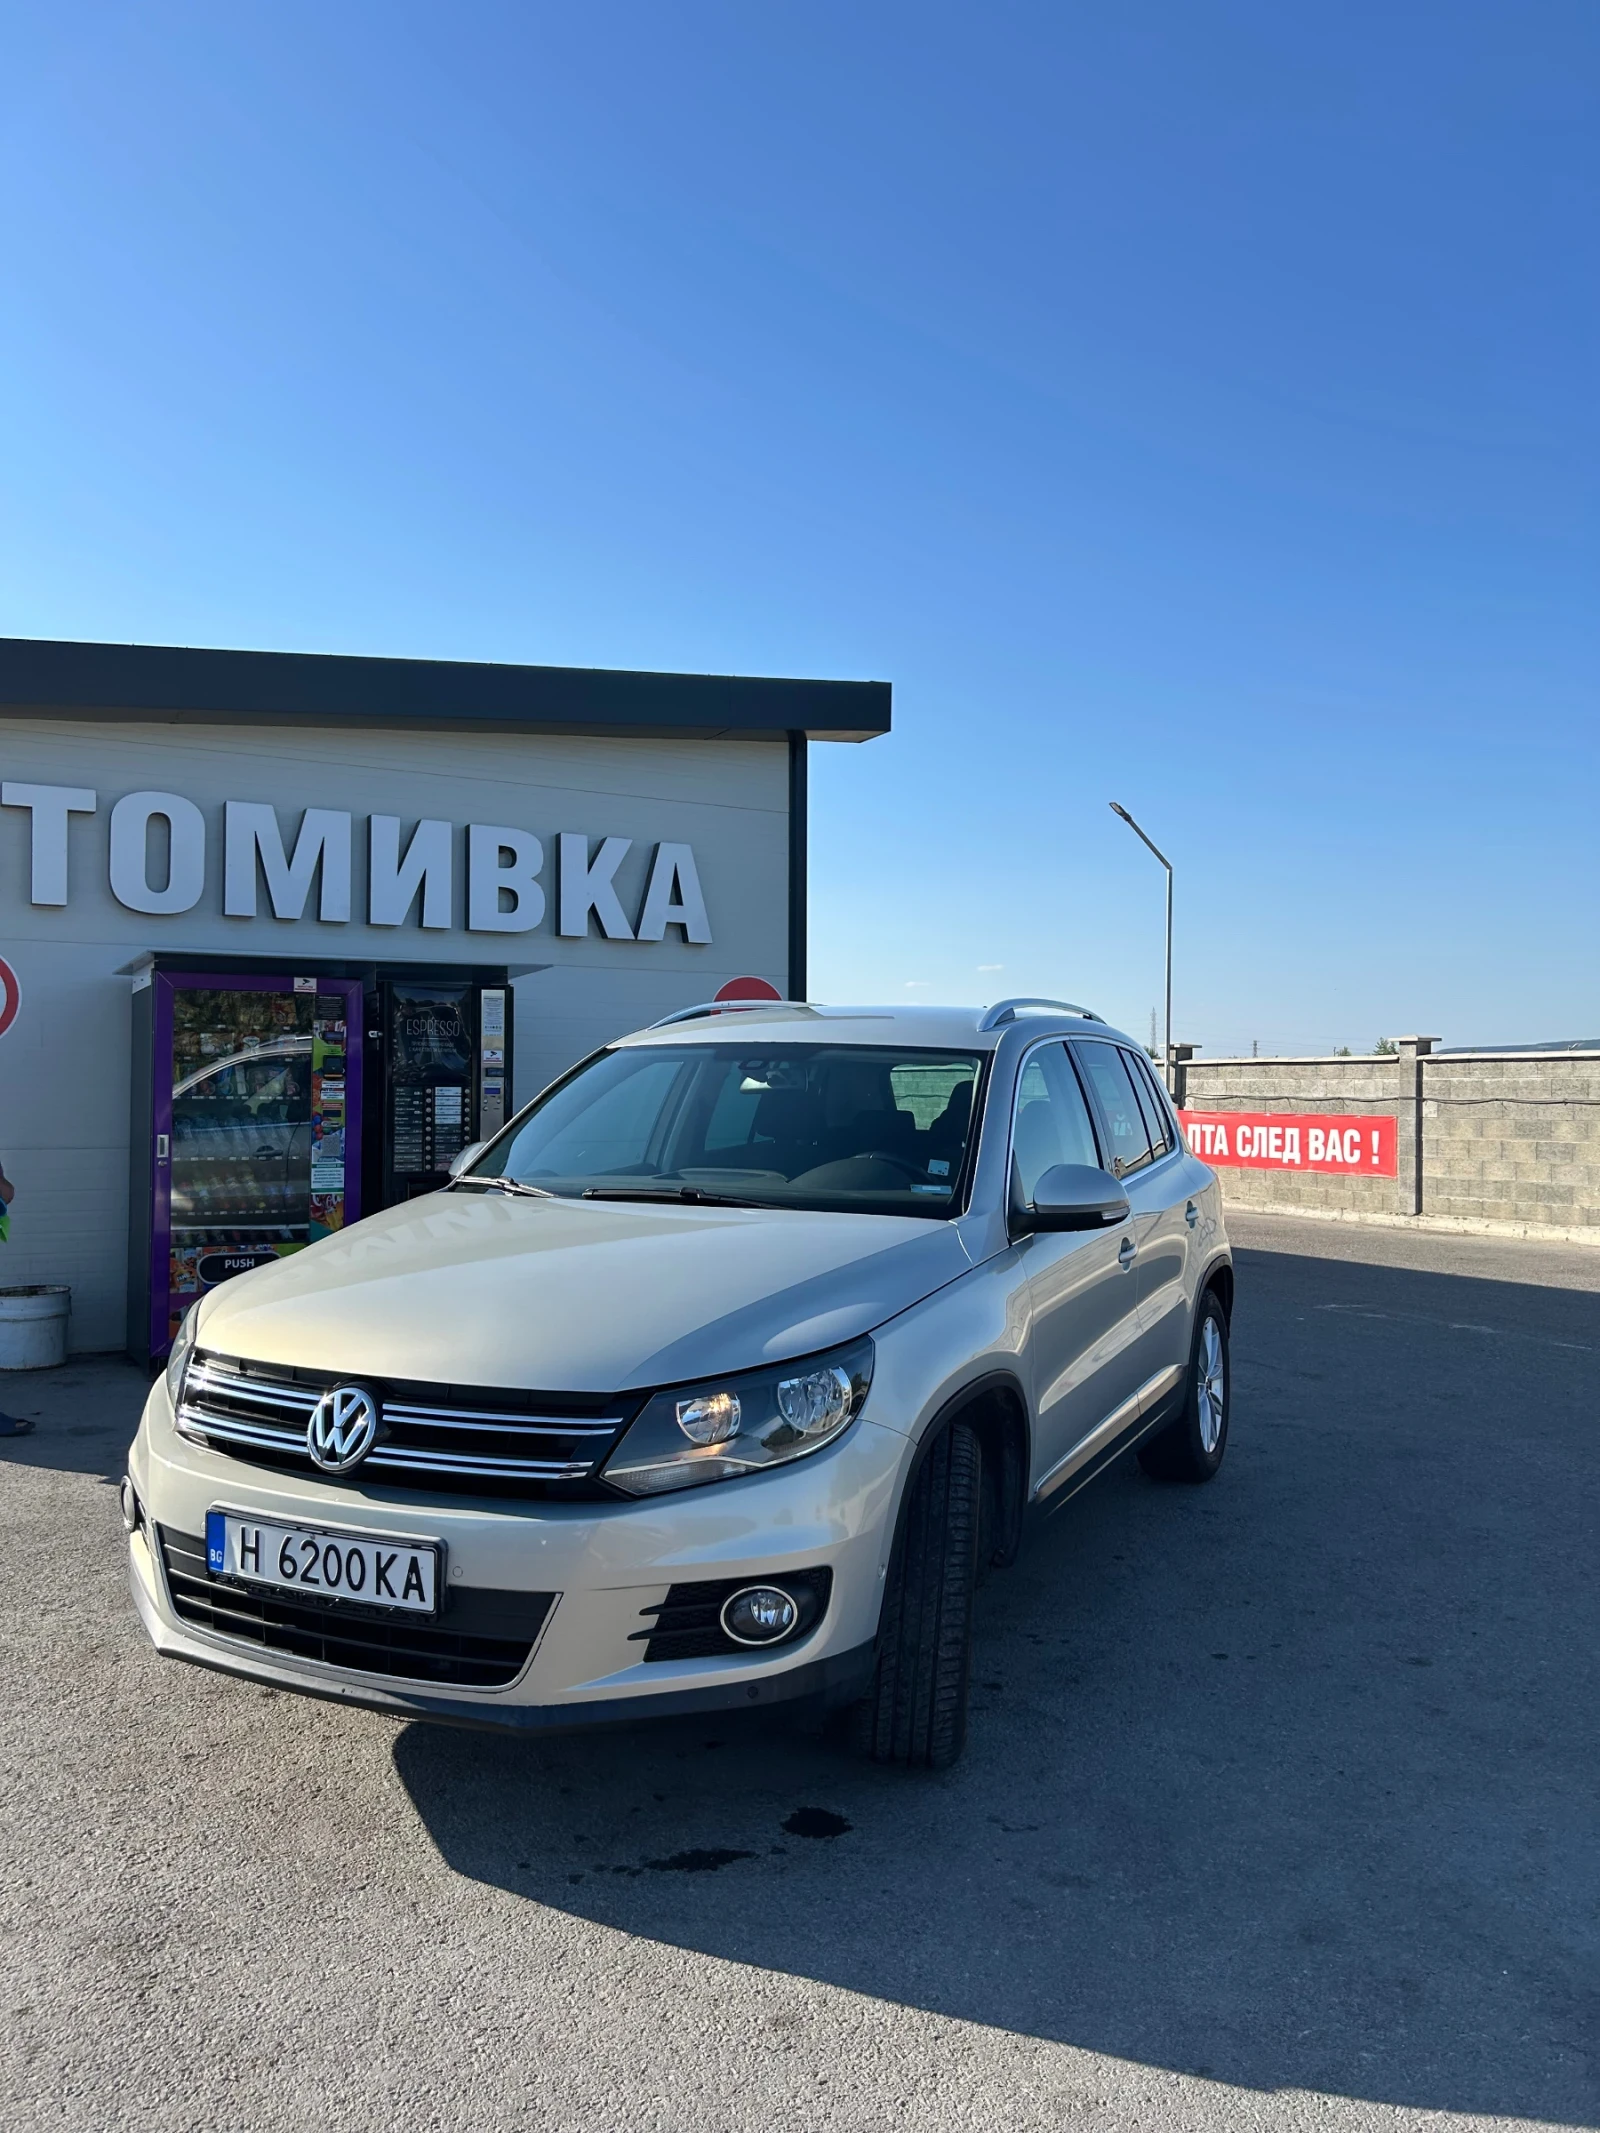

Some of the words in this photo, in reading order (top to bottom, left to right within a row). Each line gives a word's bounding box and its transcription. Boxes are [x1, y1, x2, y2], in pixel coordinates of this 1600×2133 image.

[1, 781, 712, 945] ТОМИВКА
[406, 1018, 460, 1037] ESPRESSO
[1236, 1125, 1301, 1164] СЛЕД
[1308, 1128, 1361, 1164] ВАС
[224, 1257, 255, 1269] PUSH
[209, 1548, 223, 1564] BG
[240, 1525, 260, 1573] H
[279, 1535, 366, 1592] 6200
[375, 1551, 426, 1603] KA
